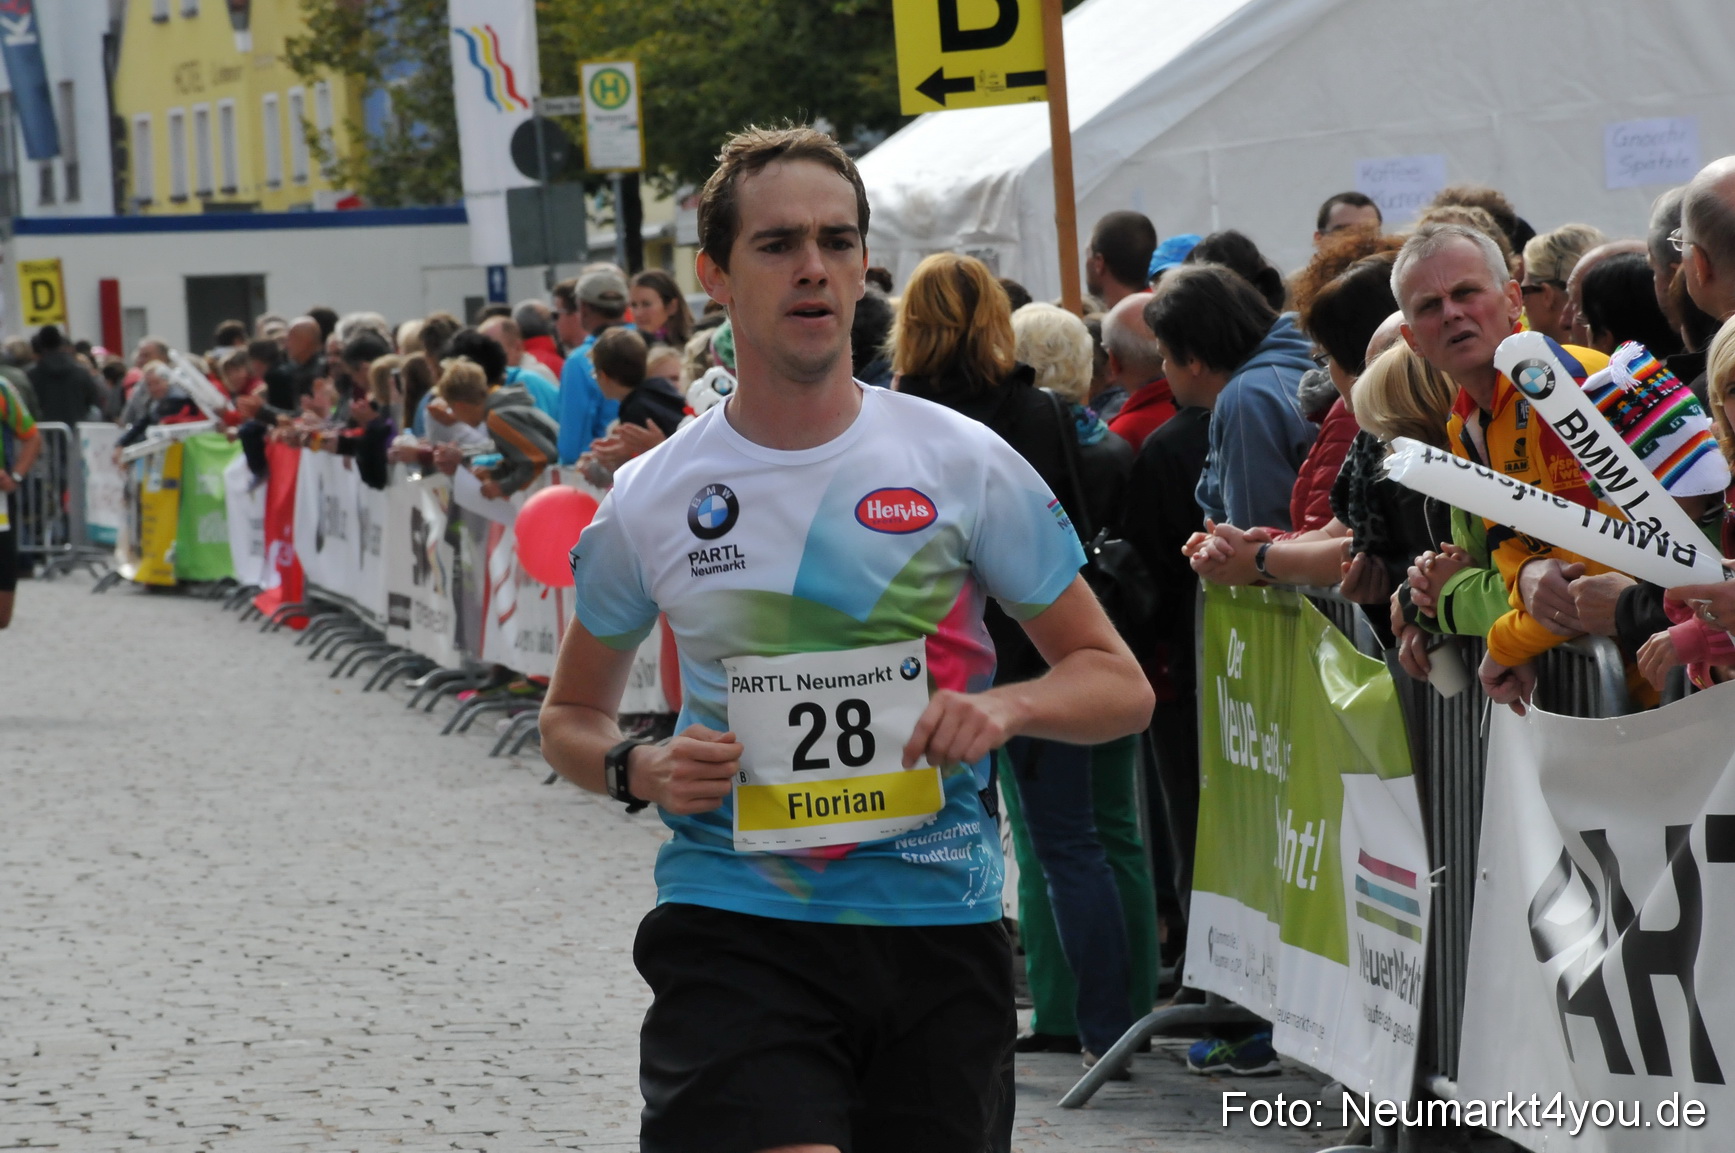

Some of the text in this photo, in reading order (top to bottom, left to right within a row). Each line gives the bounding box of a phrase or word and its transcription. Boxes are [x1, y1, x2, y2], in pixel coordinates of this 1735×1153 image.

[31, 279, 56, 311] D
[1552, 408, 1638, 493] BMW
[692, 485, 732, 509] BMW
[867, 499, 929, 521] Hervis
[688, 544, 745, 566] PARTL
[690, 559, 746, 577] Neumarkt
[1226, 627, 1246, 680] Der
[731, 665, 893, 693] PARTL Neumarkt
[788, 698, 876, 772] 28
[1216, 674, 1259, 771] Neue
[740, 771, 748, 784] B
[788, 788, 886, 821] Florian
